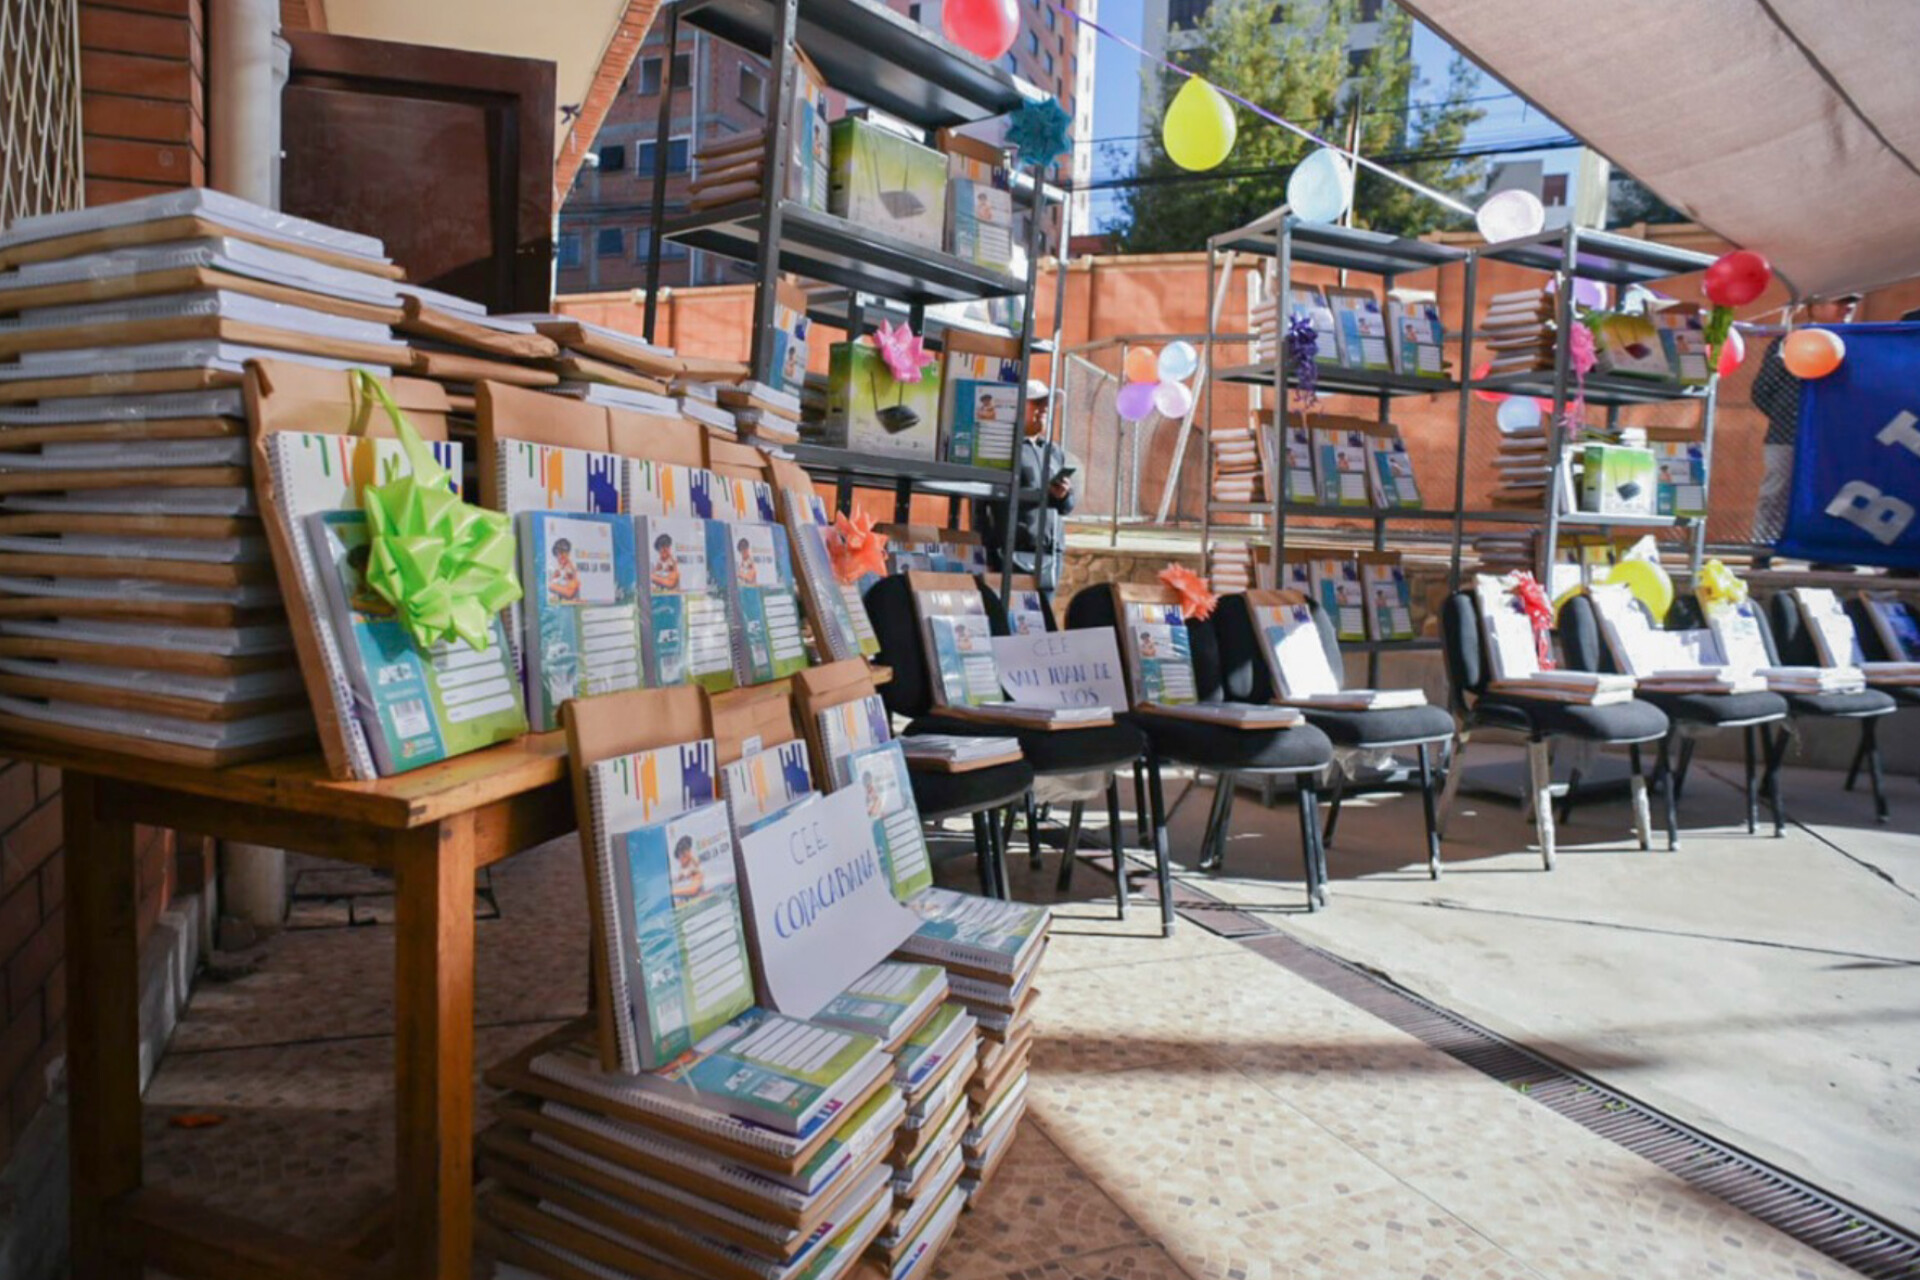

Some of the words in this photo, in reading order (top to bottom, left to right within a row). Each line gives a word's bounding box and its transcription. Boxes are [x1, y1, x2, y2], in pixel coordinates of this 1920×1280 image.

[1032, 637, 1071, 657] CEE
[790, 821, 829, 865] CEE
[774, 848, 877, 939] COPACABANA
